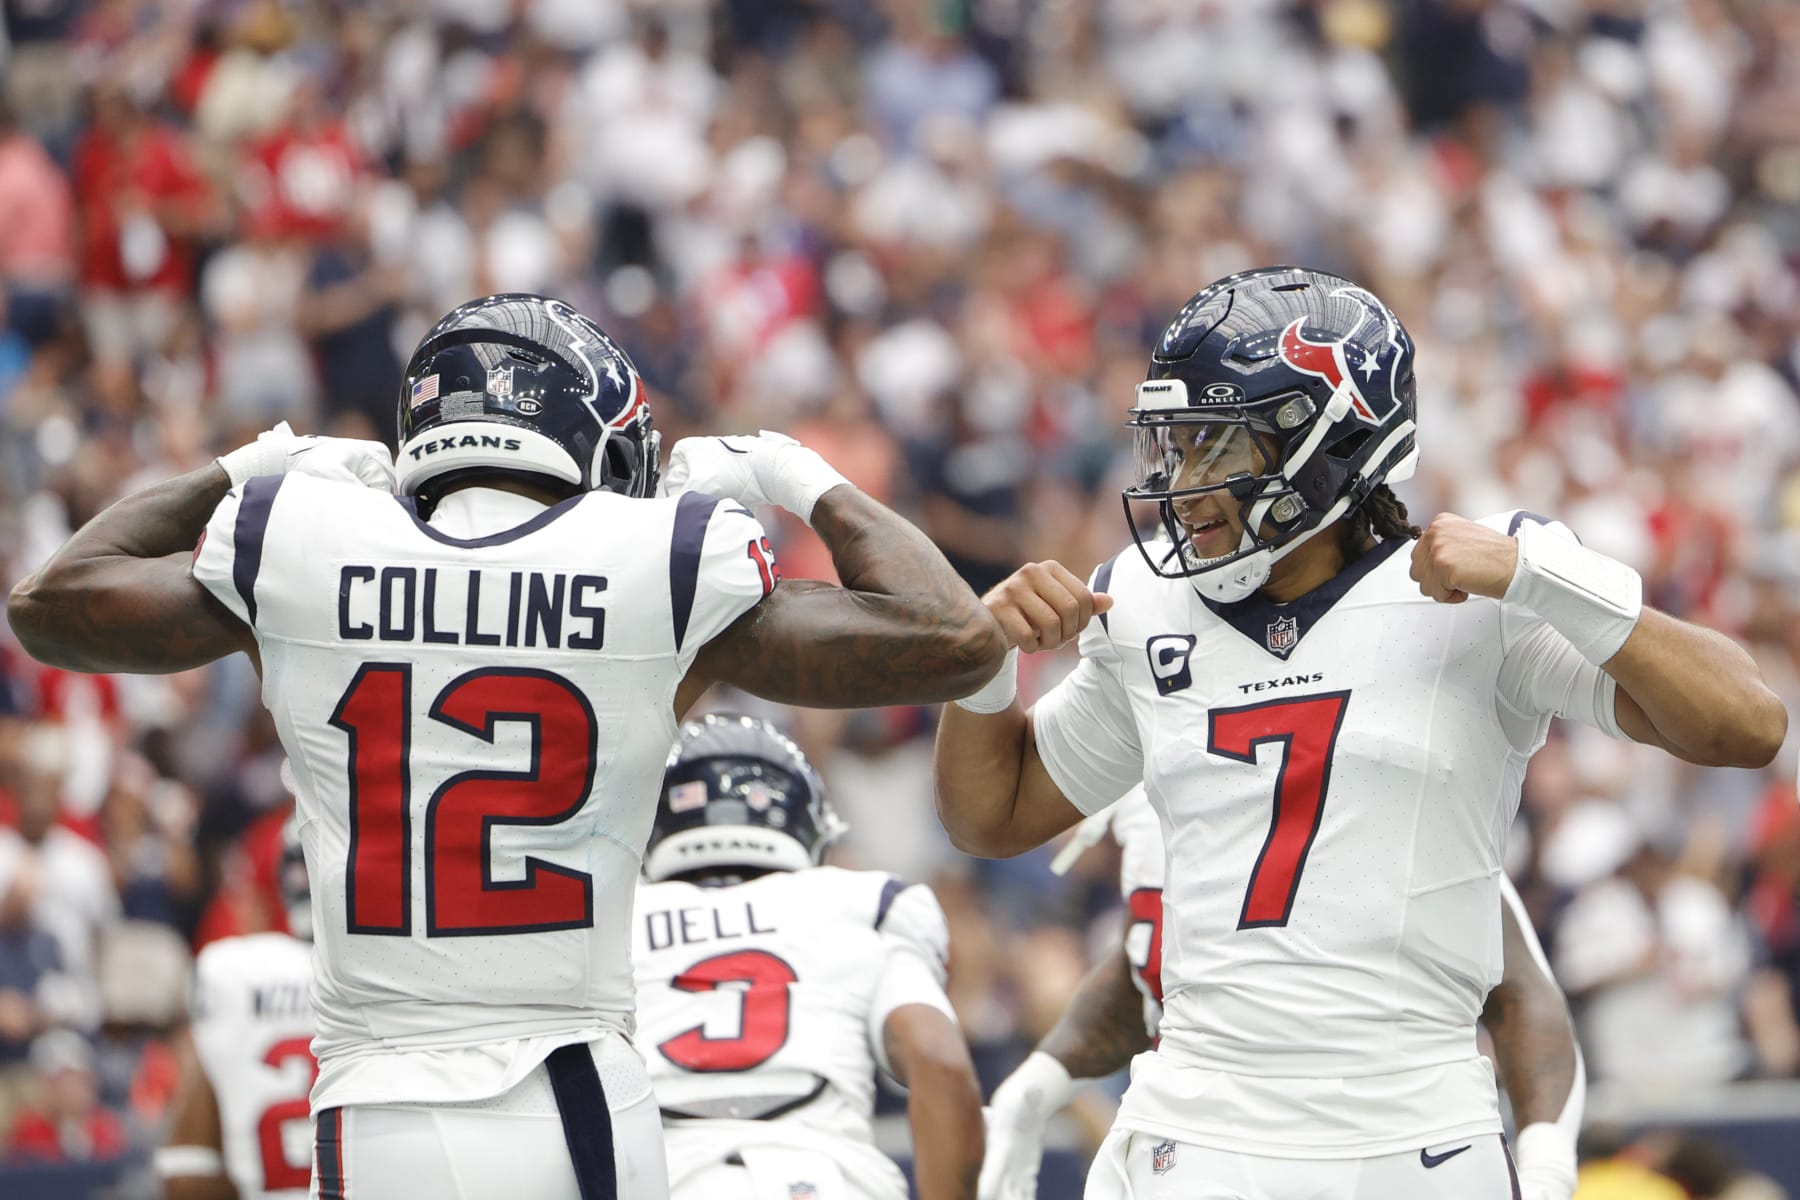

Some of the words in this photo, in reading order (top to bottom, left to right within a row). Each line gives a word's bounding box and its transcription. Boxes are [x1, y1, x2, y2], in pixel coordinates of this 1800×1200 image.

[490, 379, 509, 392] NFL
[1201, 396, 1241, 404] OAKLEY
[409, 435, 522, 461] TEXANS
[338, 565, 609, 651] COLLINS
[1271, 631, 1293, 648] NFL
[1150, 637, 1190, 680] C
[1237, 672, 1324, 694] TEXANS
[327, 661, 599, 939] 12
[1206, 688, 1353, 931] 7
[677, 840, 777, 855] TEXANS
[645, 900, 778, 952] DELL
[657, 948, 800, 1073] 3
[1155, 1153, 1174, 1169] NFL
